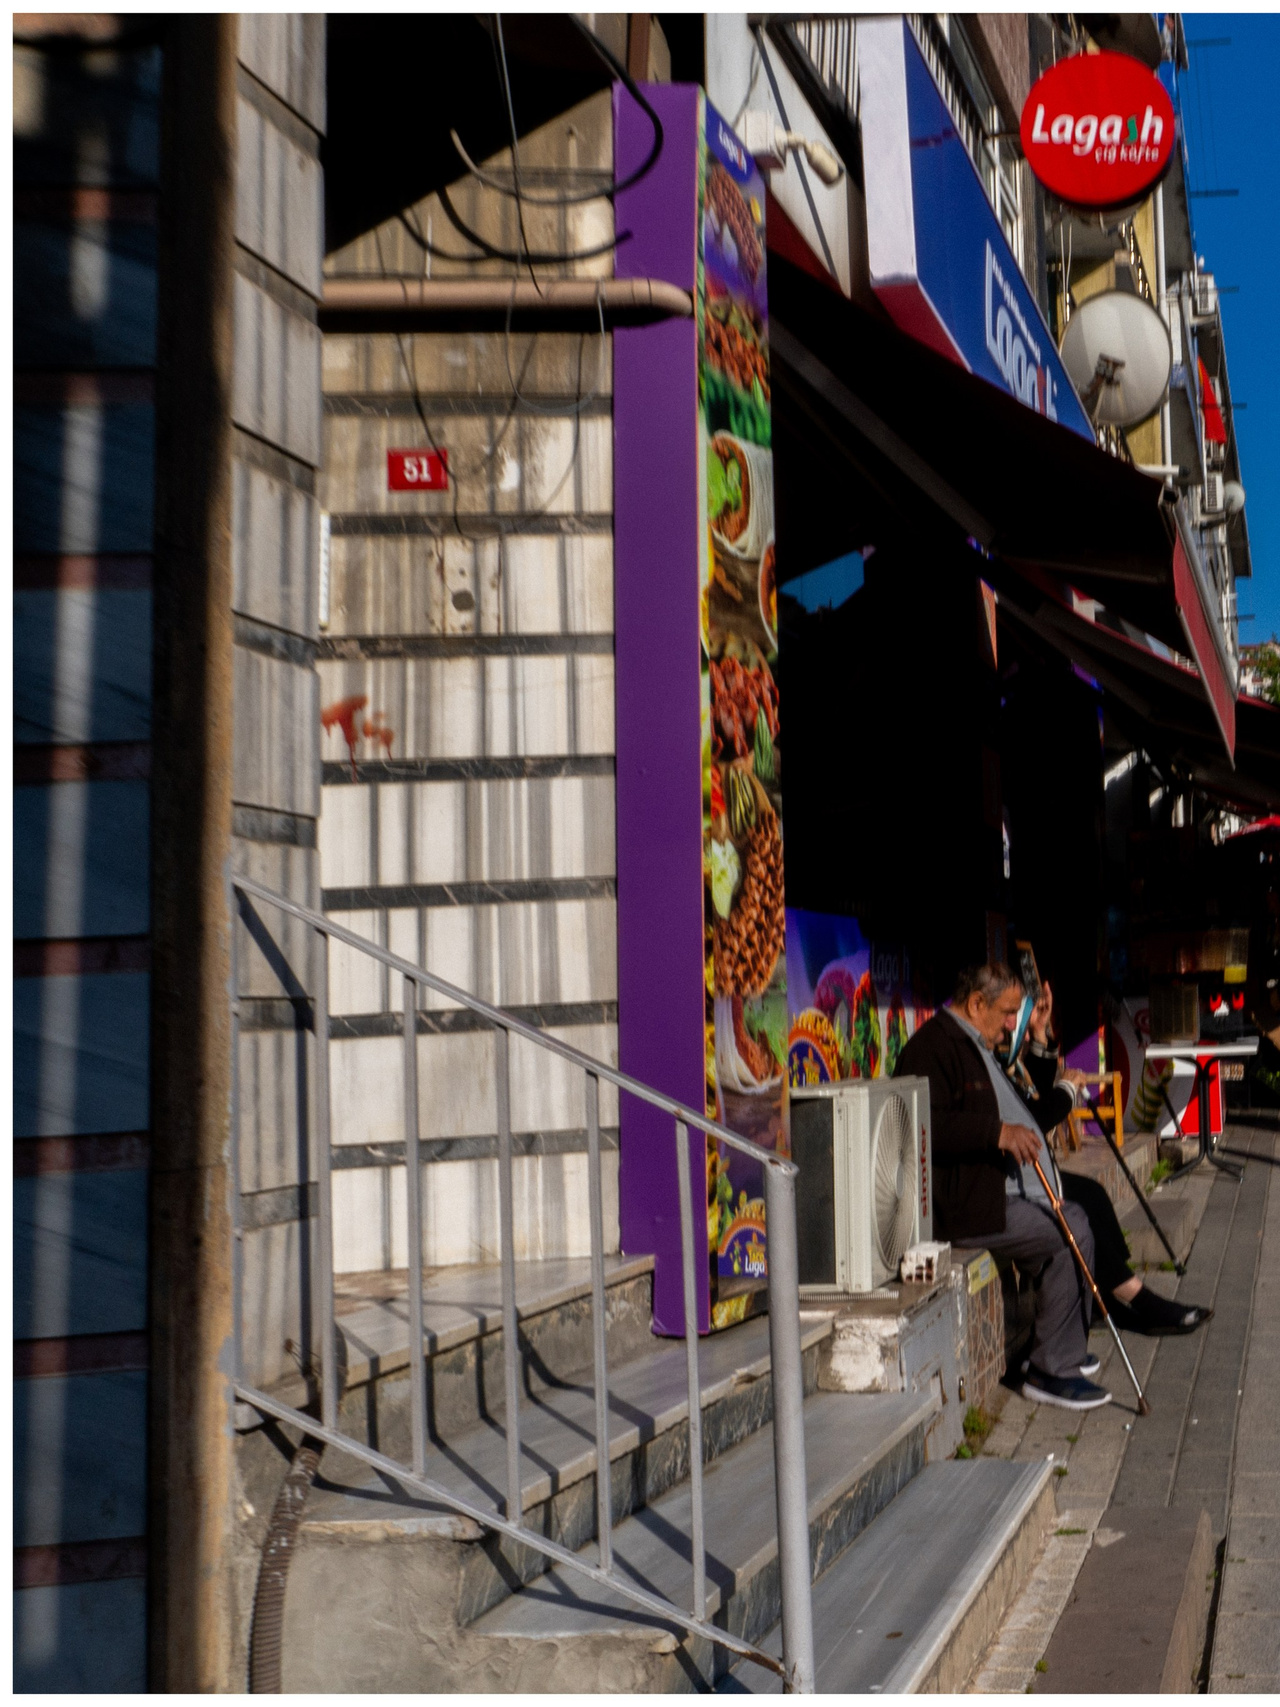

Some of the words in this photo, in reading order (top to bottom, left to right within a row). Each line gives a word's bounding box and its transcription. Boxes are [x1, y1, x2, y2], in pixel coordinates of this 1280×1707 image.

[1032, 104, 1163, 156] Lagash
[403, 457, 432, 483] 51
[744, 1255, 768, 1278] Laga
